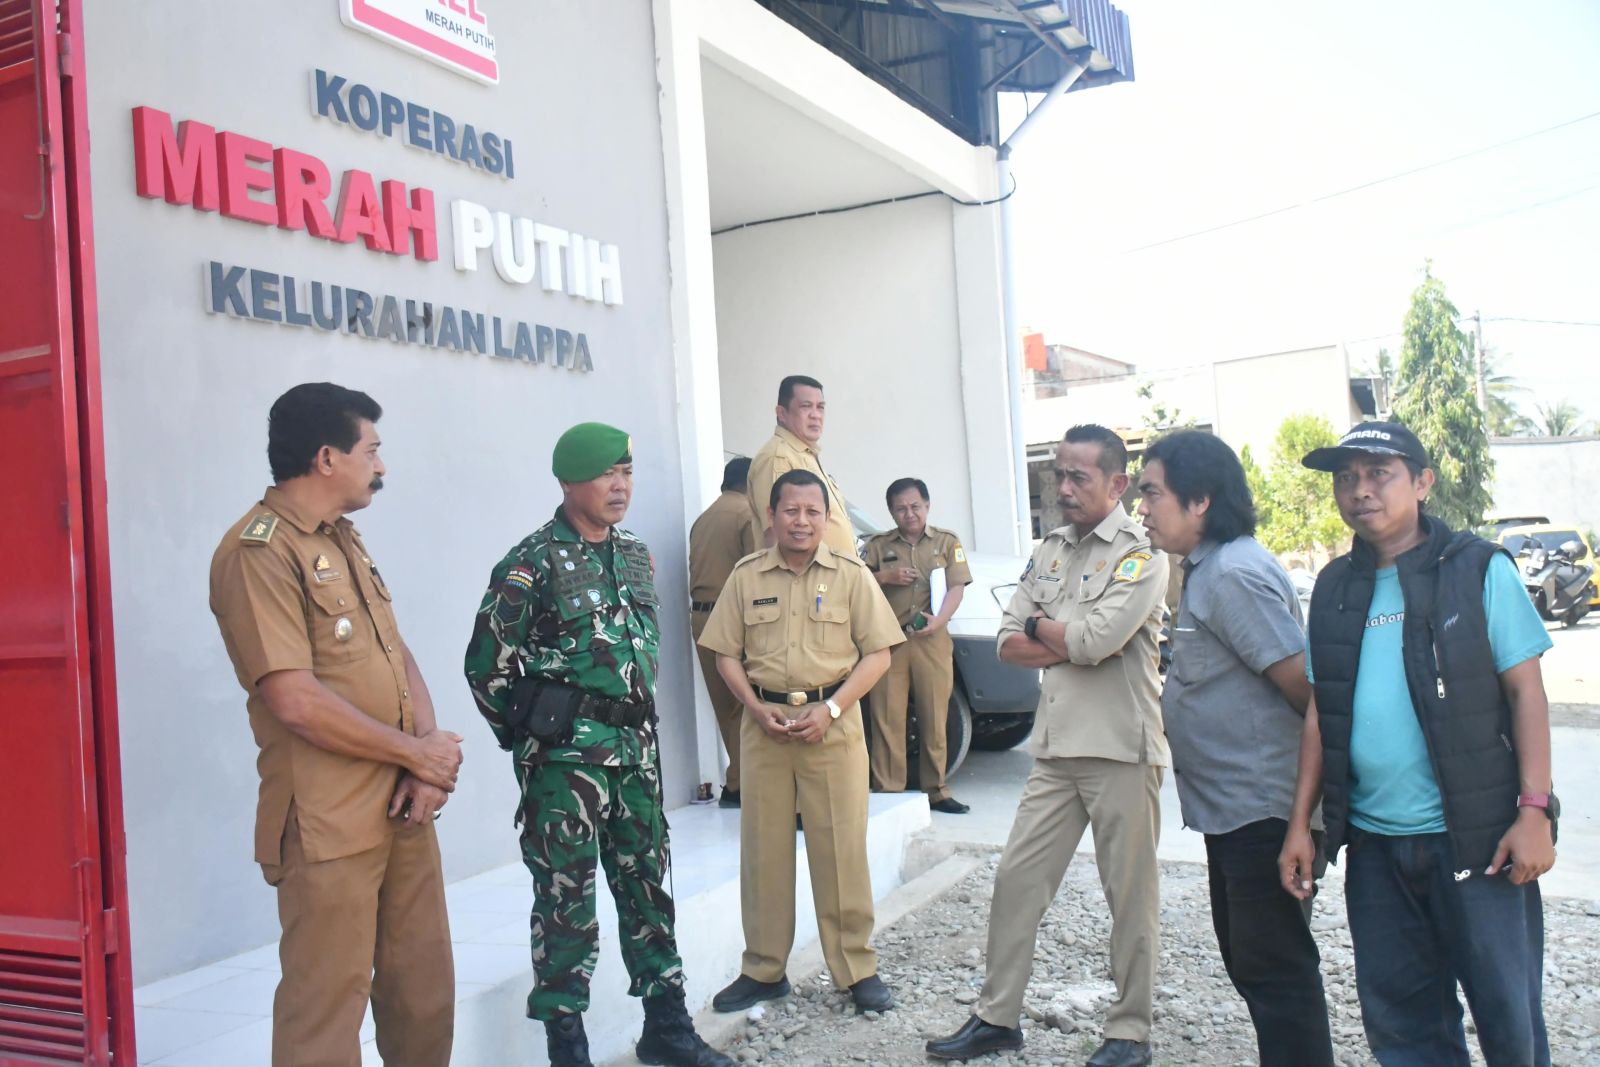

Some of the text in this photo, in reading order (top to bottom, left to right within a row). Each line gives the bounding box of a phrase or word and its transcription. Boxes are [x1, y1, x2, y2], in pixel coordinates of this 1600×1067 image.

[425, 9, 463, 36] MERAH
[465, 27, 495, 51] PUTIH
[313, 69, 514, 180] KOPERASI
[131, 106, 623, 305] MERAH PUTIH
[207, 261, 594, 372] KELURAHAN LAPPA
[1339, 430, 1391, 446] MANO
